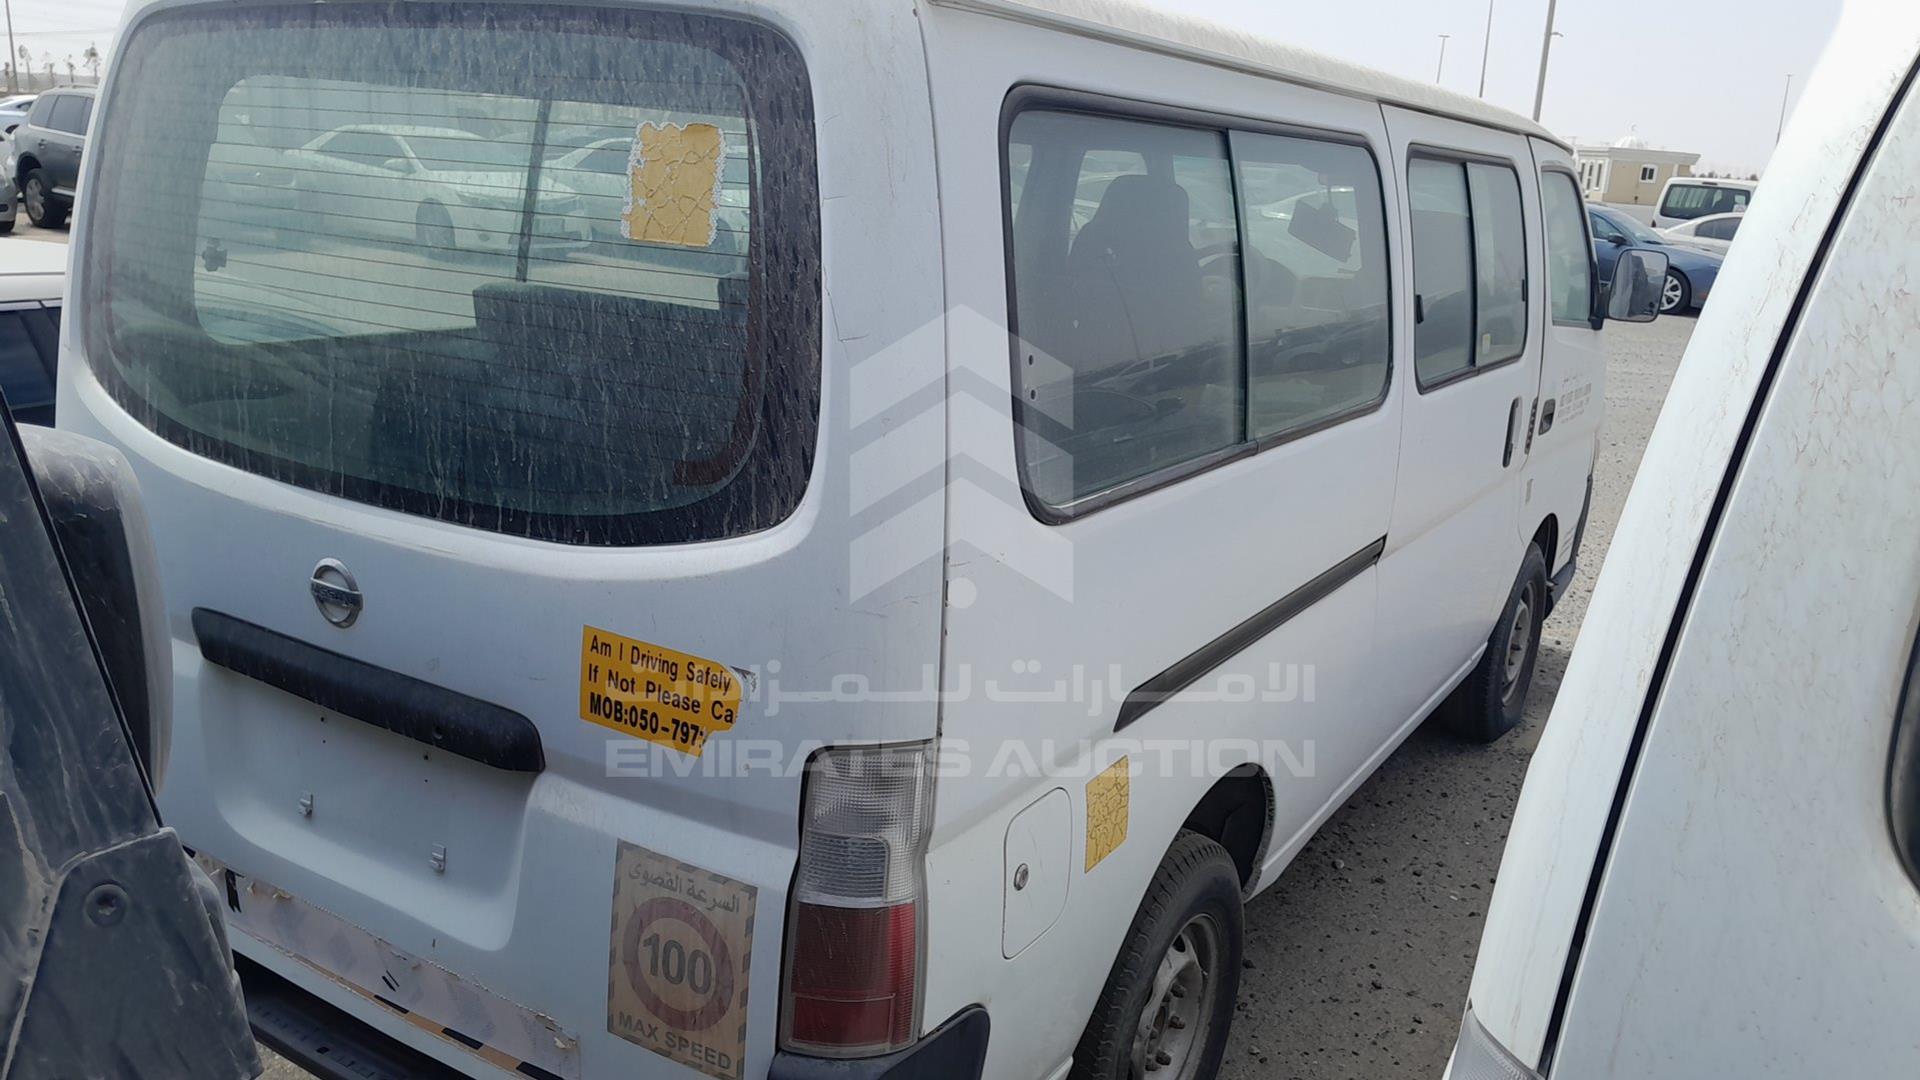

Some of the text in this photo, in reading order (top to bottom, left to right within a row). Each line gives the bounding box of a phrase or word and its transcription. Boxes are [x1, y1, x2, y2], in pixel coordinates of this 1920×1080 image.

[588, 663, 738, 724] If Not Please Ca
[590, 635, 732, 696] Am I Driving Safely
[628, 862, 740, 914] السرعة القصوى
[642, 932, 712, 995] 100
[618, 1011, 732, 1071] MAX SPEED
